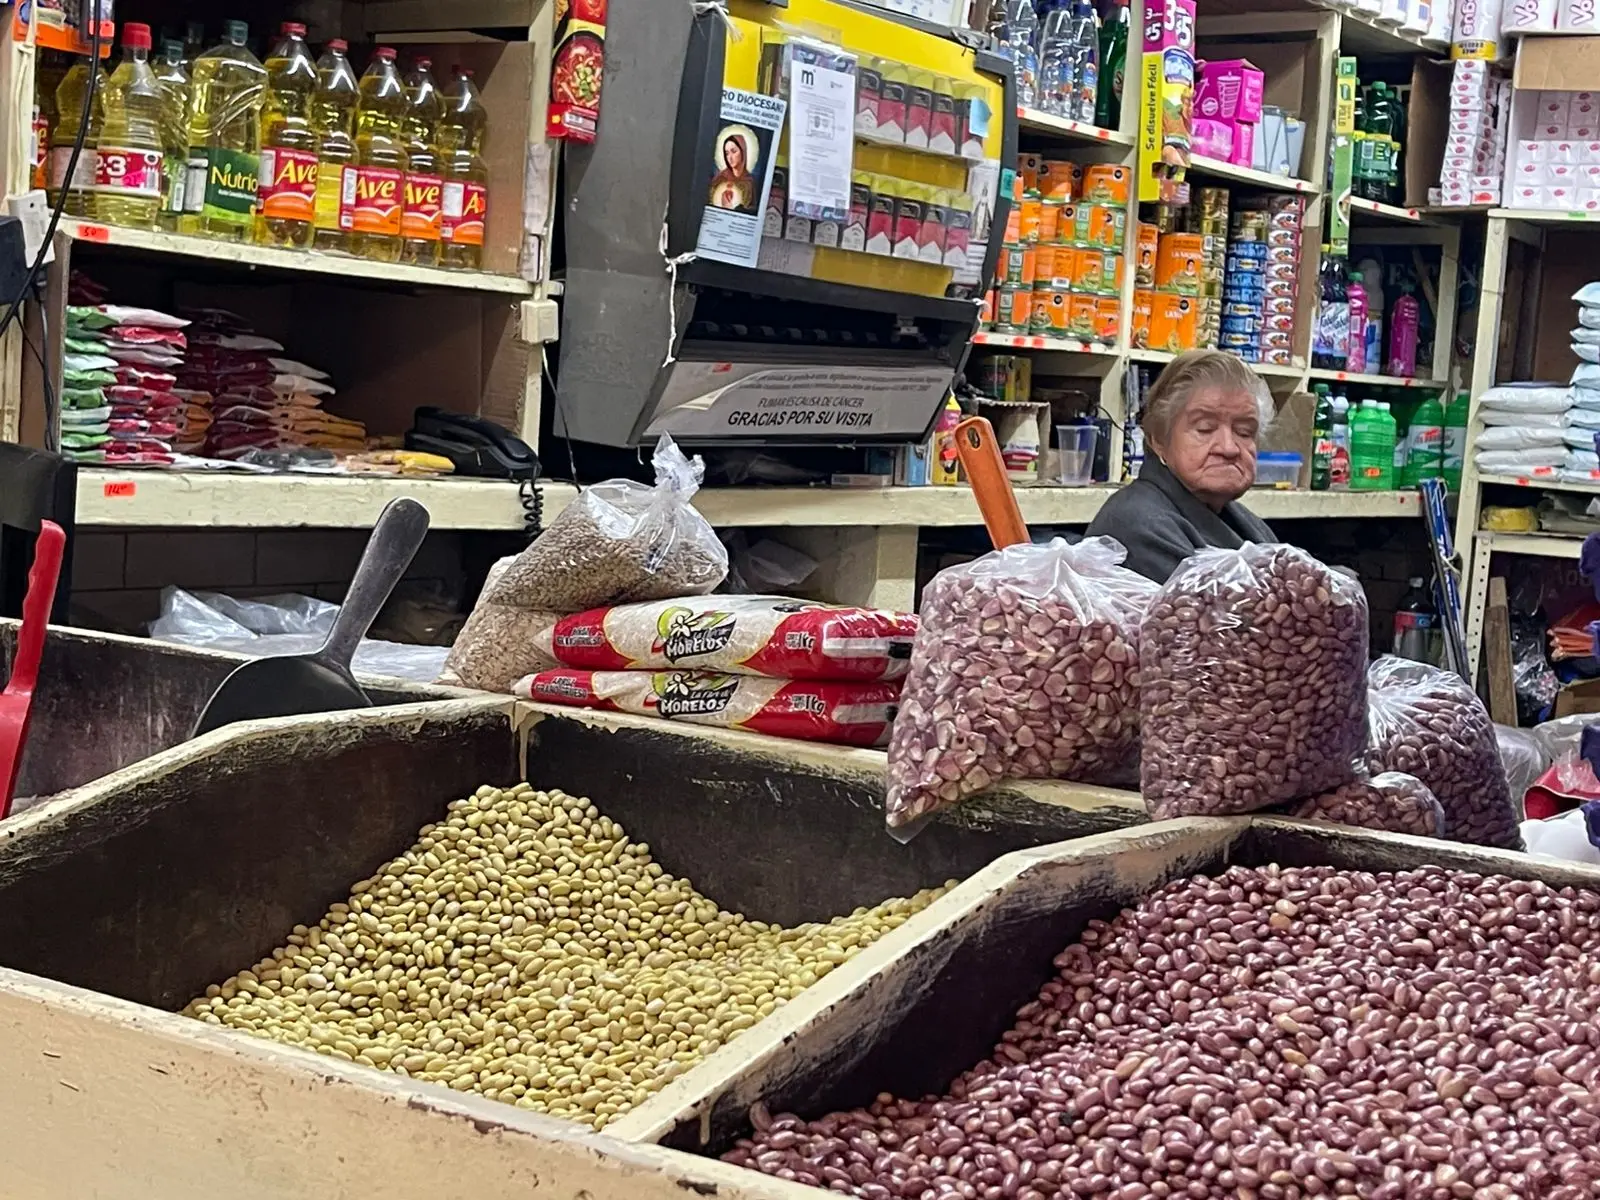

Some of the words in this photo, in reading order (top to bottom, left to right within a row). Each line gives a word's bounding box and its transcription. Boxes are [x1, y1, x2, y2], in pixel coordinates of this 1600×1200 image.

[1146, 90, 1157, 135] disuelve
[1145, 138, 1156, 151] Se
[275, 159, 318, 187] Ave
[356, 176, 397, 200] Ave
[403, 183, 440, 205] Ave
[727, 410, 787, 427] GRACIAS
[786, 410, 816, 425] POR
[815, 411, 836, 425] SU
[835, 411, 873, 427] VISITA
[666, 636, 724, 657] MORELOS
[660, 697, 728, 715] MORELOS
